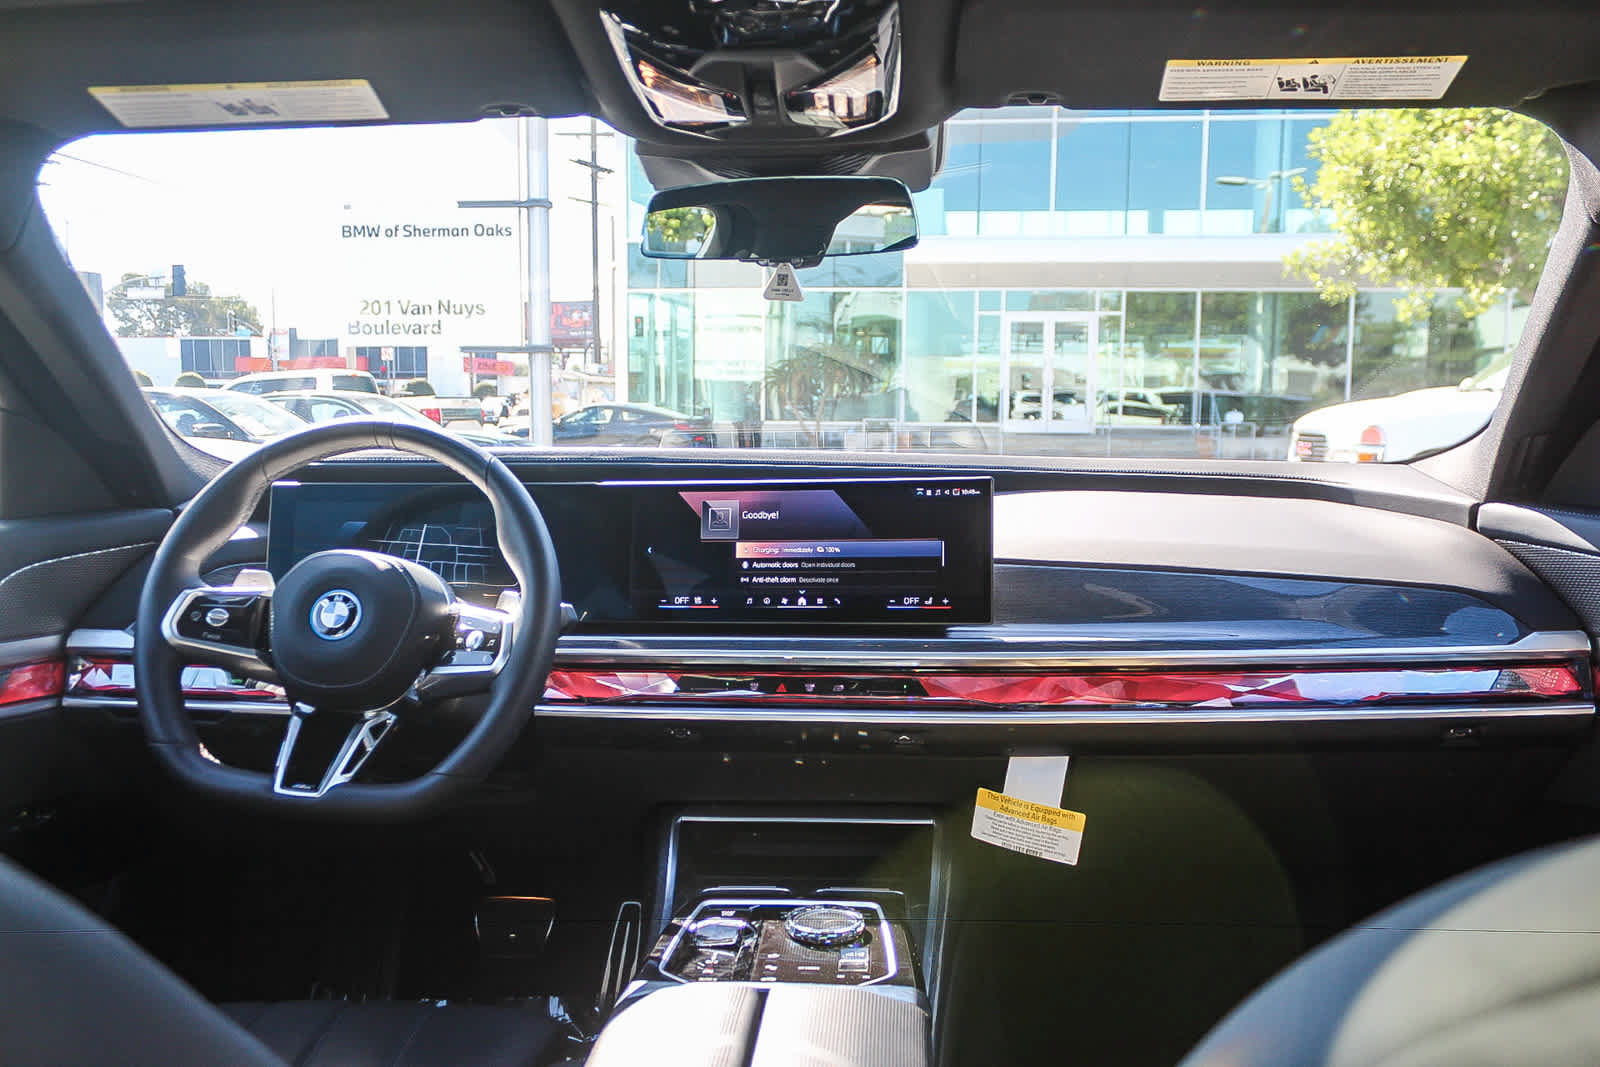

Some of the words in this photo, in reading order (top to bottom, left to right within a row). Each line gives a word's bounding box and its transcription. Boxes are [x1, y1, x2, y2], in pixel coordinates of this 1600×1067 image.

[1352, 56, 1449, 65] AVERTISSEMENT
[341, 224, 381, 239] BMW
[384, 224, 400, 238] of
[402, 224, 470, 238] Sherman
[473, 223, 513, 238] Oaks
[359, 299, 392, 315] 201
[398, 299, 433, 315] Van
[437, 299, 487, 319] Nuys
[348, 319, 442, 335] Boulevard
[741, 510, 779, 520] Goodbye!
[674, 596, 690, 605] OFF
[903, 596, 920, 605] OFF
